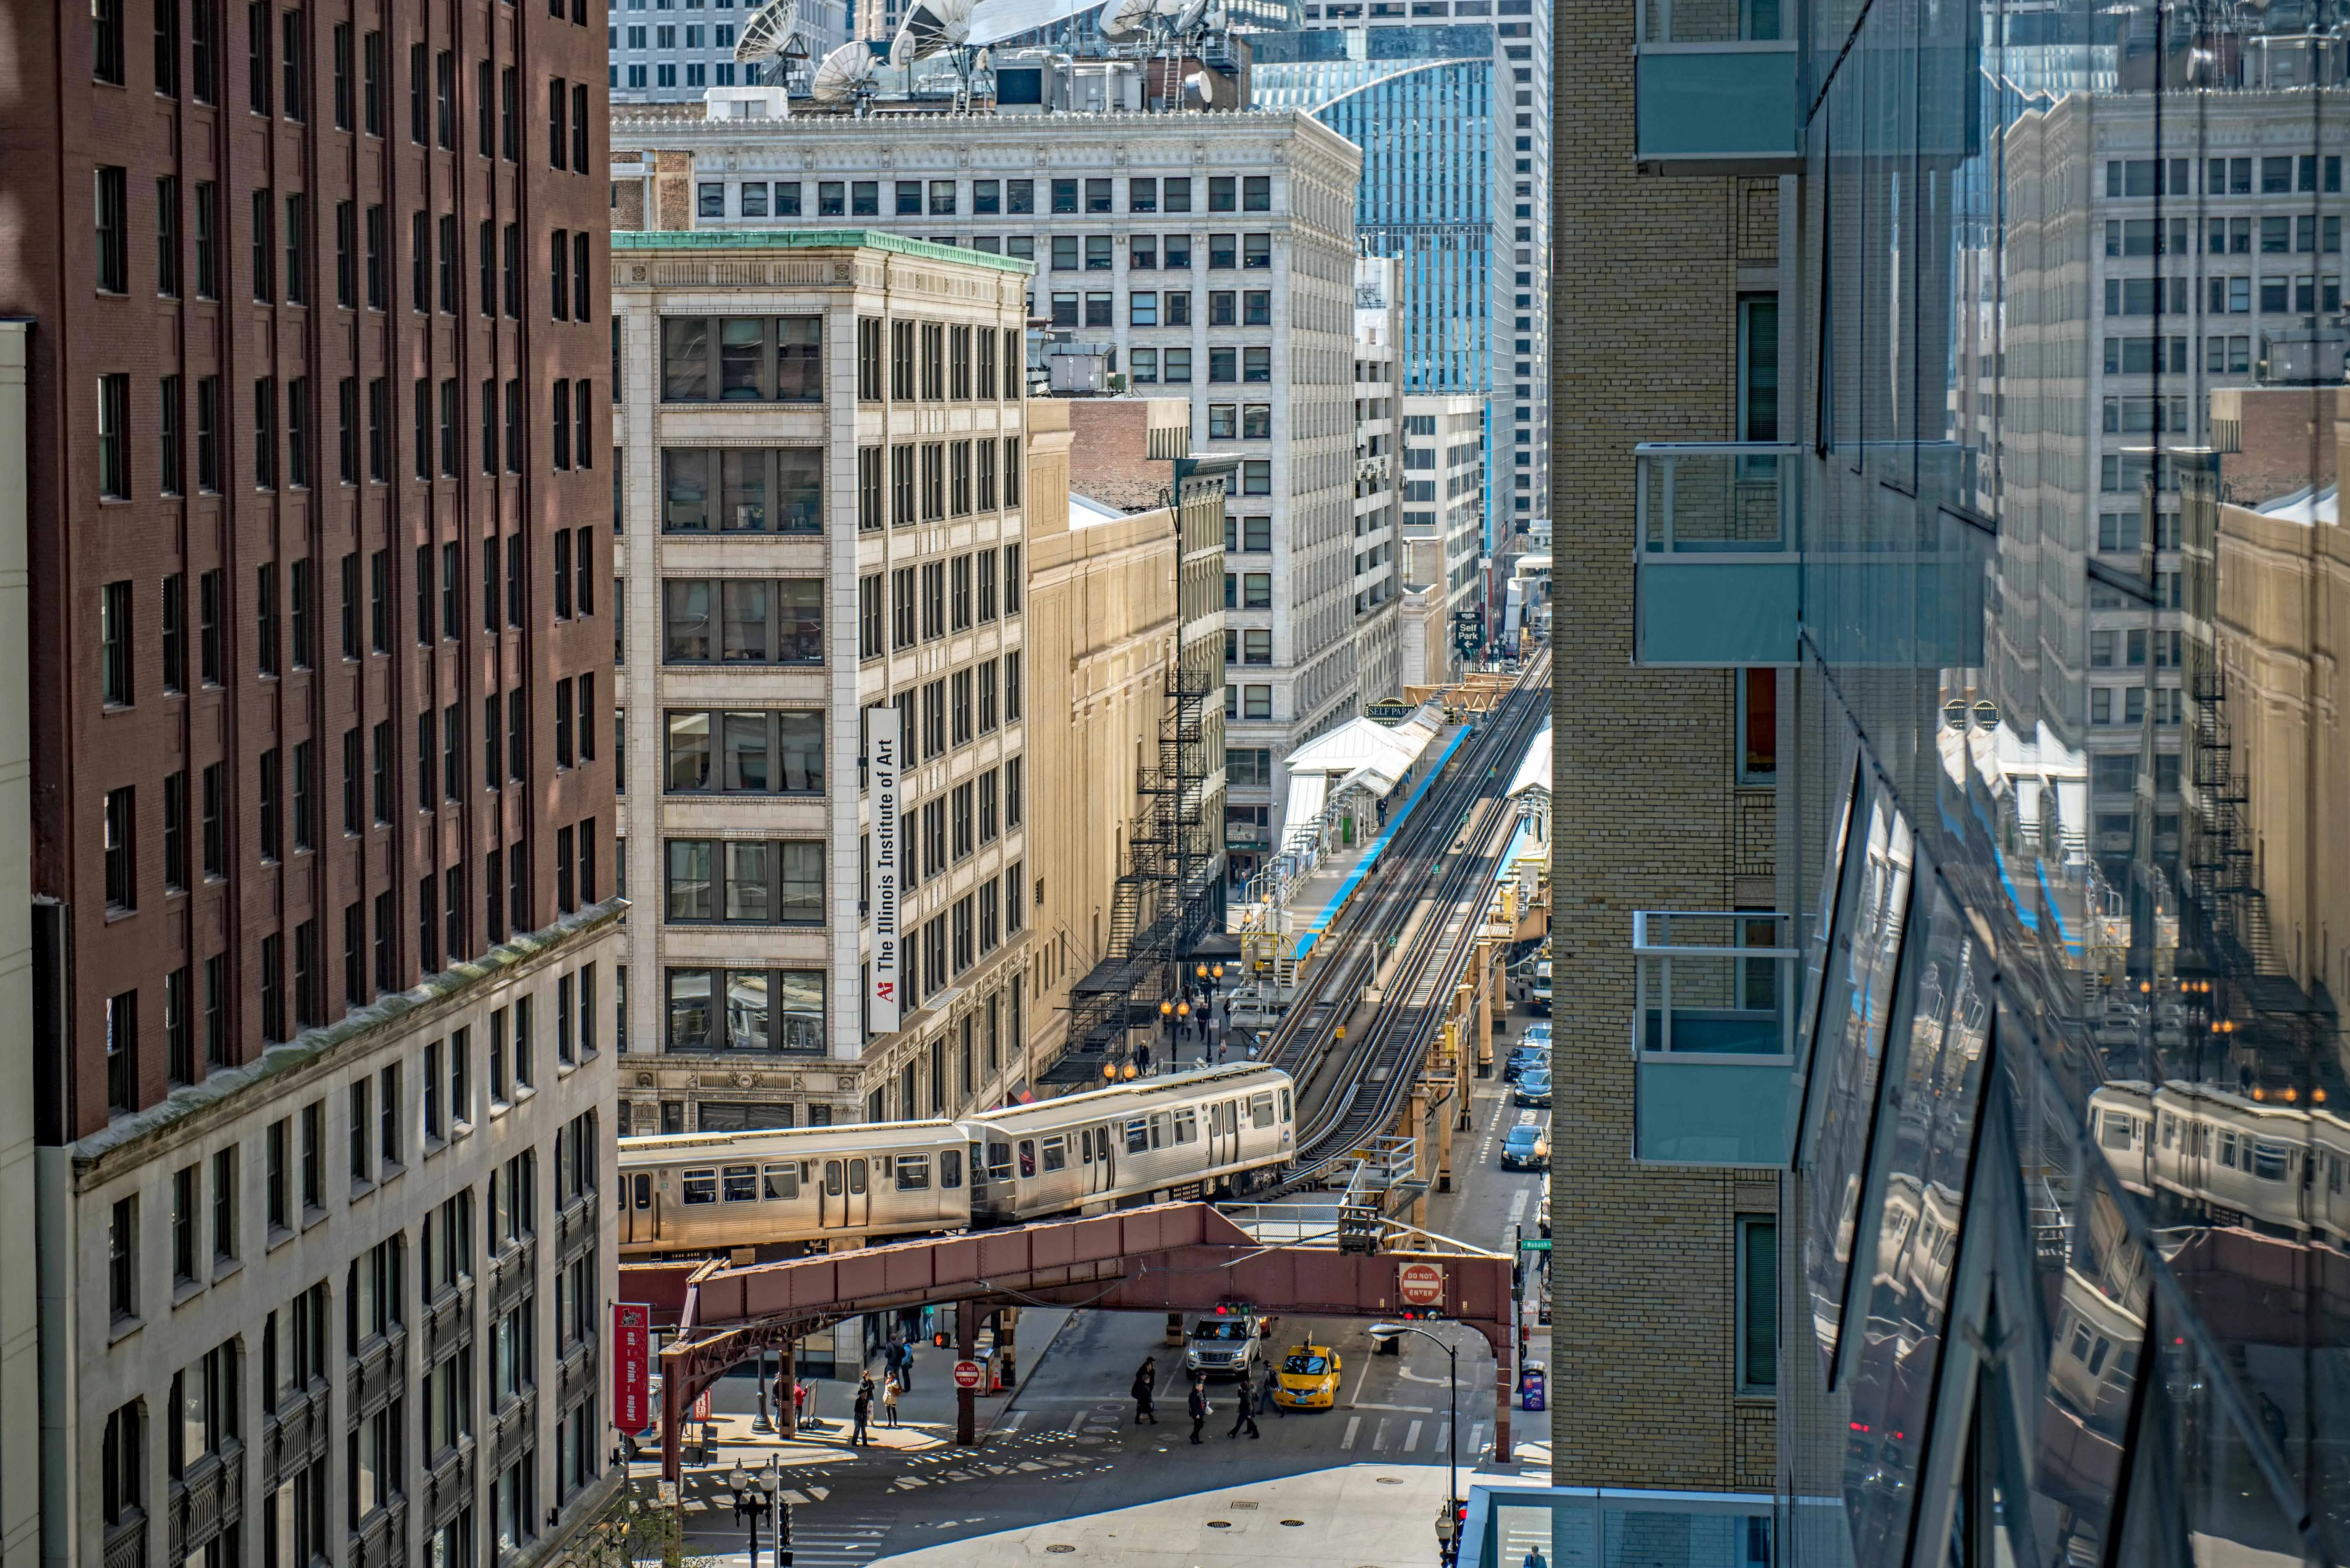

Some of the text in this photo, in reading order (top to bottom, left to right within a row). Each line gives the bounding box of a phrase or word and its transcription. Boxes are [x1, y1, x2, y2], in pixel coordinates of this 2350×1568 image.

[877, 739, 894, 972] The Illinois Institute of Art
[627, 1395, 636, 1421] enjoy!
